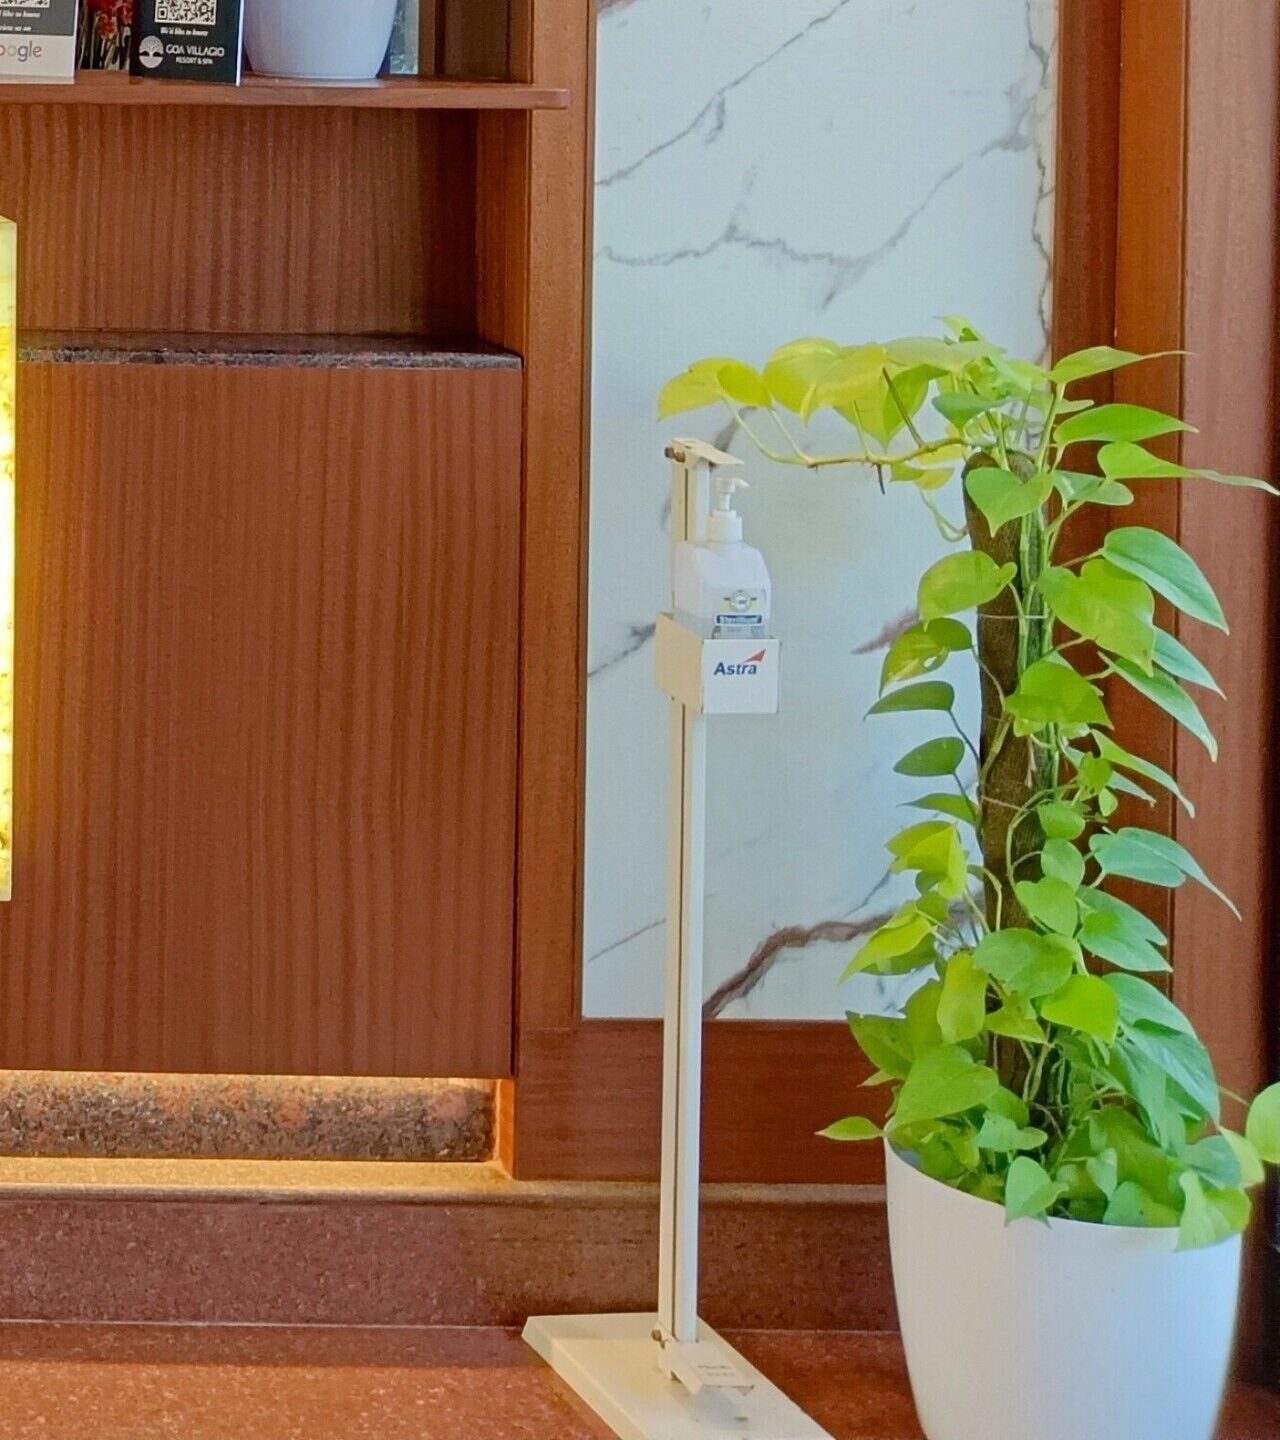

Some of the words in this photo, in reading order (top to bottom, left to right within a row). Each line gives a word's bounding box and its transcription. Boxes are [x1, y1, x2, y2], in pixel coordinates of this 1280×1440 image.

[165, 43, 185, 54] GOA
[186, 45, 225, 57] VILLAGIO
[713, 662, 758, 676] Astra
